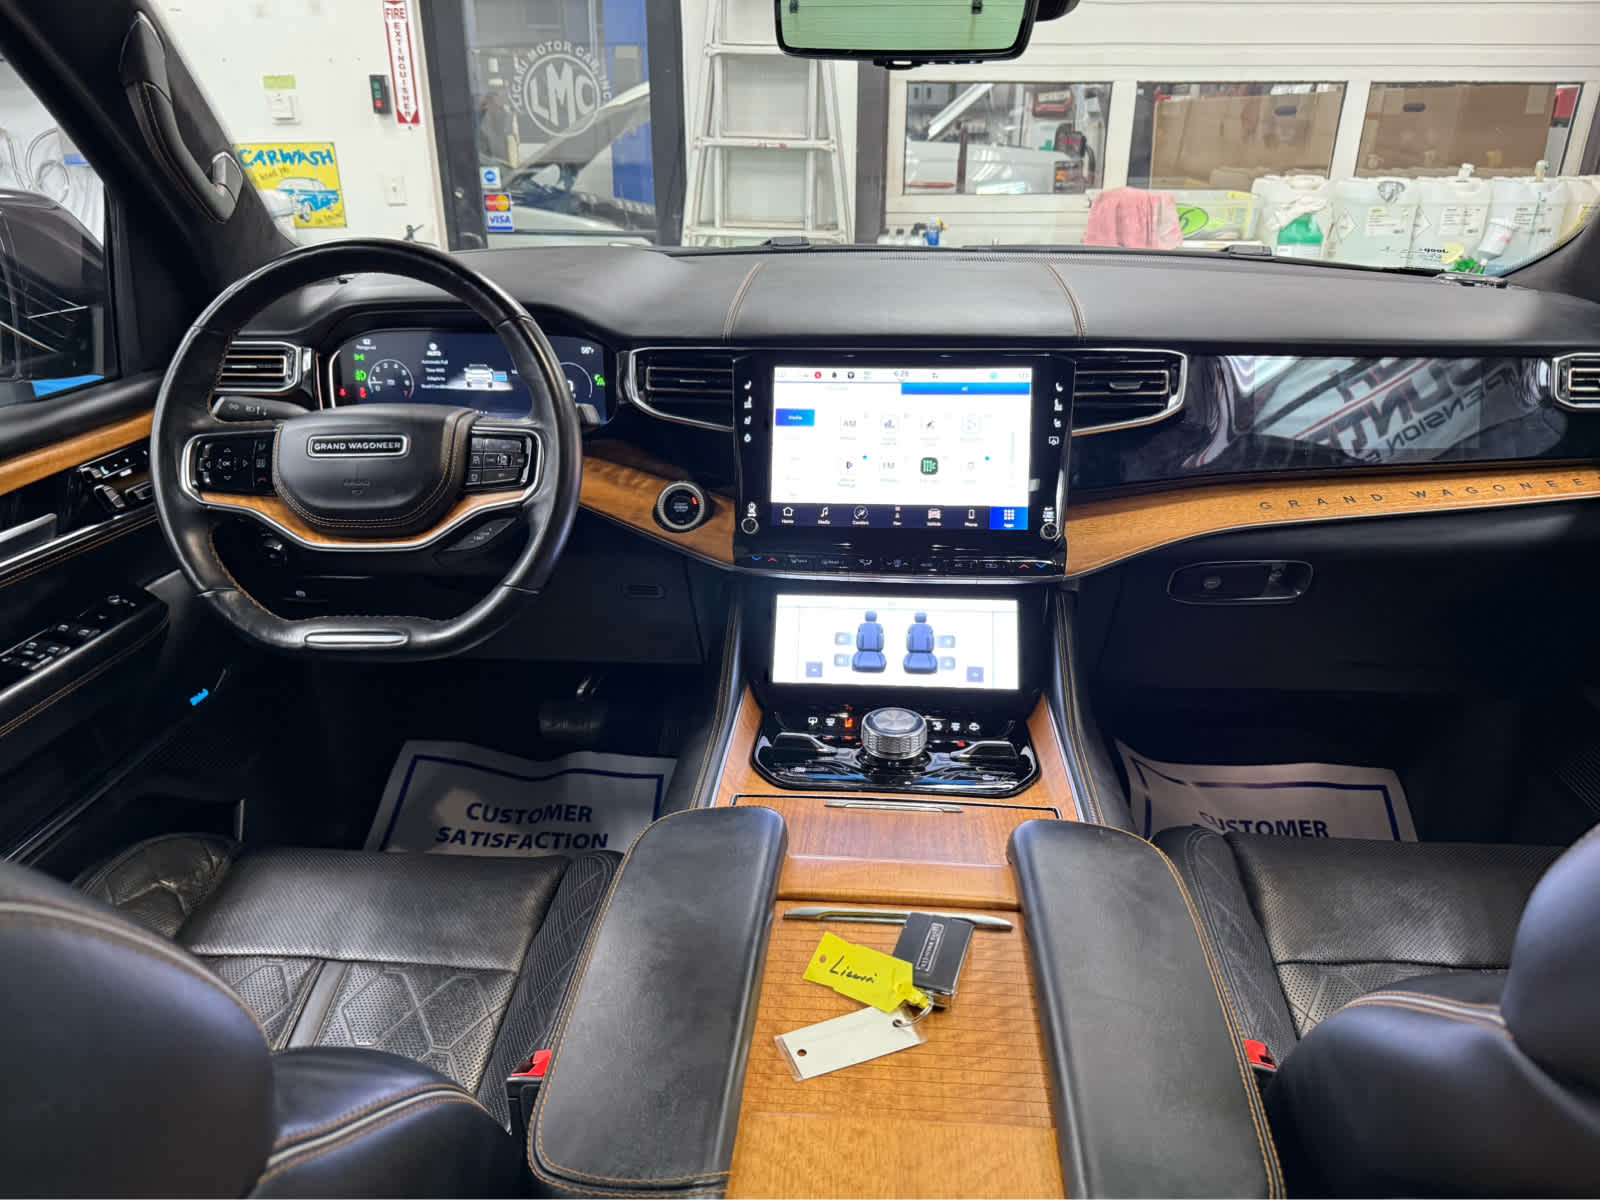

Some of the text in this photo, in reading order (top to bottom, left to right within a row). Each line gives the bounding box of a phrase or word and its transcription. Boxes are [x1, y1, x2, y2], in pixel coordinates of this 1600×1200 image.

[385, 7, 406, 19] FIRE
[527, 40, 573, 62] MOTOR
[394, 22, 411, 117] EXTINGUISHER
[529, 61, 597, 127] LMC
[489, 215, 512, 224] VISA
[314, 440, 401, 451] GRAND WAGONEER
[1259, 475, 1600, 511] GRAND WAGONEE
[466, 802, 593, 825] CUSTOMER
[434, 826, 609, 850] SATISFACTION
